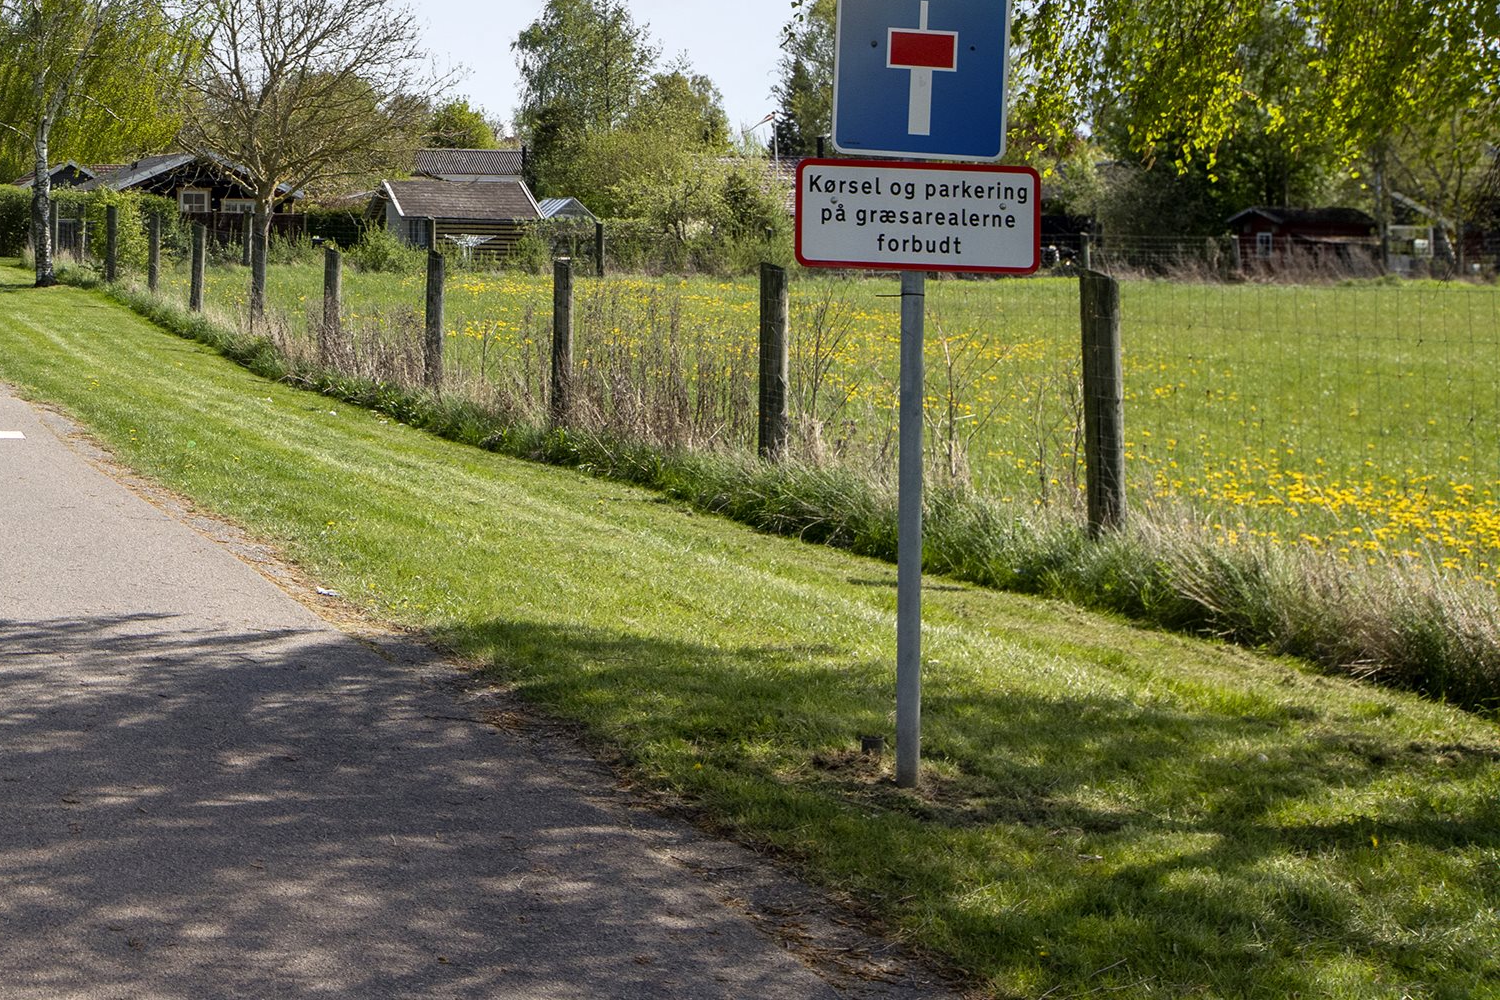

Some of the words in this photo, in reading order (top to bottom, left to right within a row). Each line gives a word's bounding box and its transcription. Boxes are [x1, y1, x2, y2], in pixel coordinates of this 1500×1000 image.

[810, 175, 881, 194] Kørsel
[890, 182, 914, 199] og
[926, 181, 1027, 204] parkering
[822, 203, 845, 224] på
[856, 209, 1015, 228] græsarealerne
[877, 234, 961, 254] forbudt
